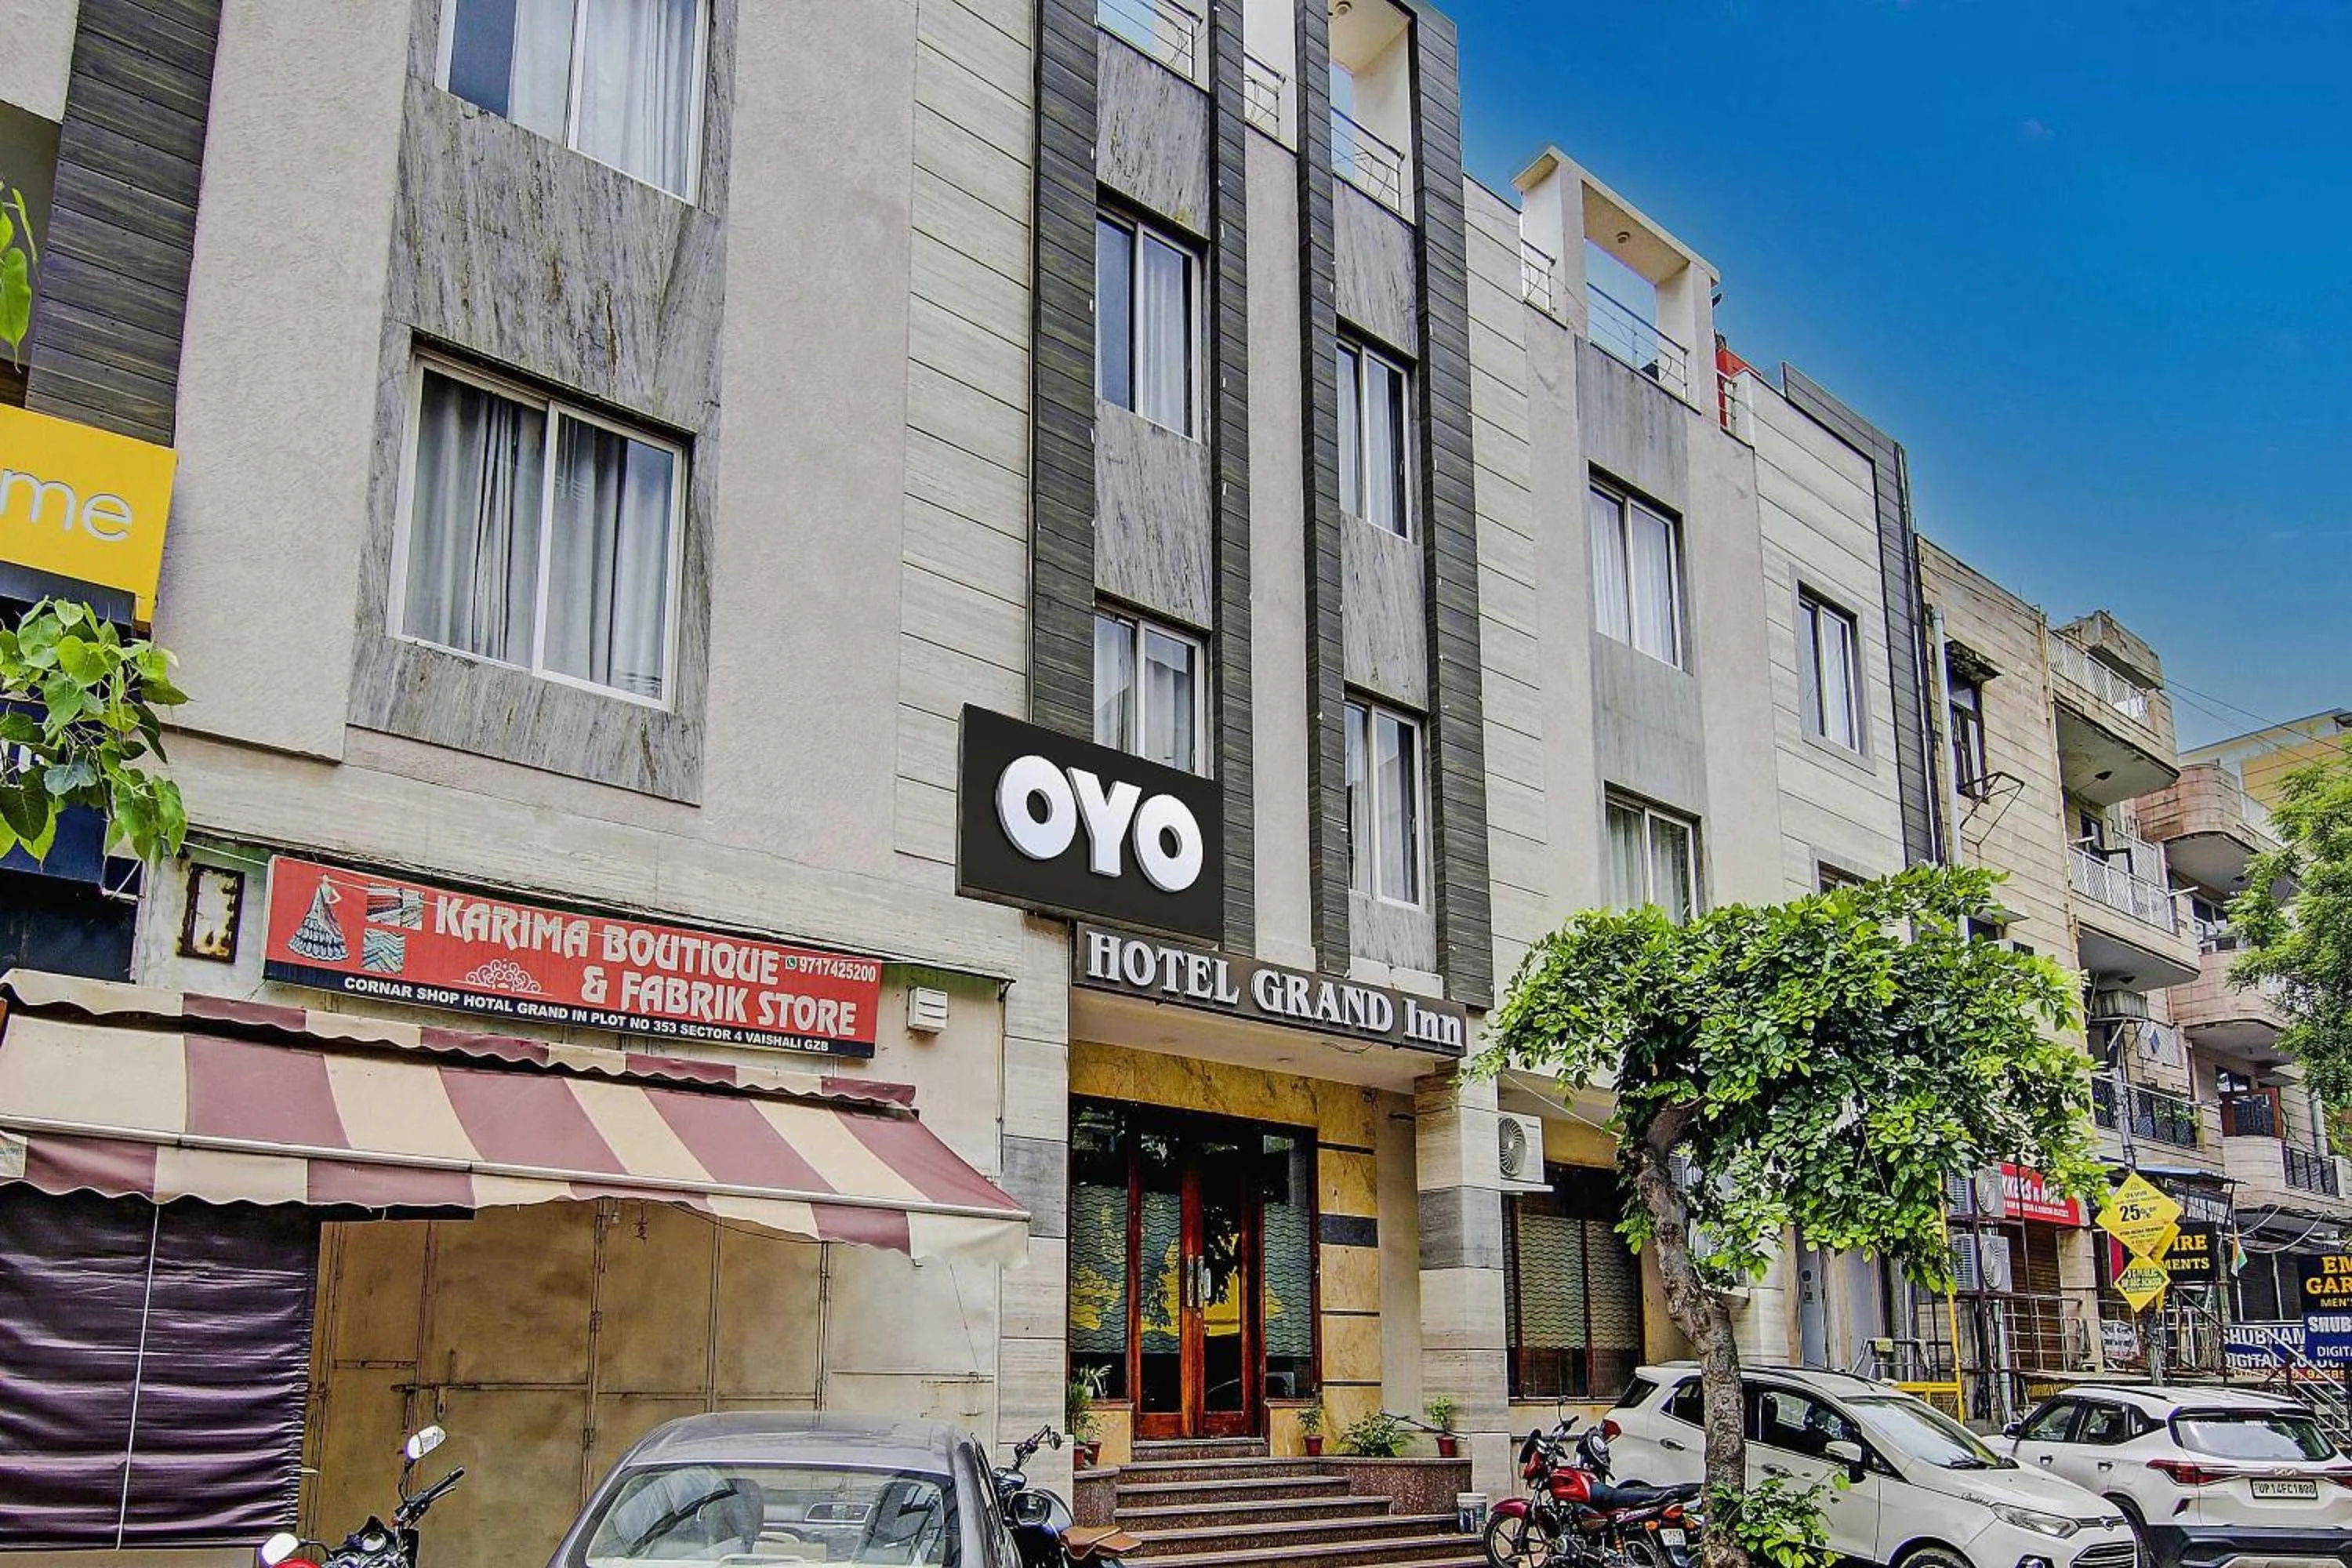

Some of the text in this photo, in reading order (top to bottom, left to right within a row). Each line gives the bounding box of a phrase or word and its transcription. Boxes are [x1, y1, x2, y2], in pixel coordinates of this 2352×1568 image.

[996, 754, 1203, 892] OYO
[435, 895, 779, 985] KARIMA BOUTIQUE
[798, 958, 877, 982] 9717425200
[344, 976, 829, 1051] CORNAR SHOP HOTAL GRAND IN PLOT NO 353 SECTOR 4 VAISHALI GZB
[581, 965, 858, 1039] & FABRIK STORE
[1086, 931, 1463, 1047] HOTEL GRAND Inn
[2317, 1346, 2352, 1357] DIGIT
